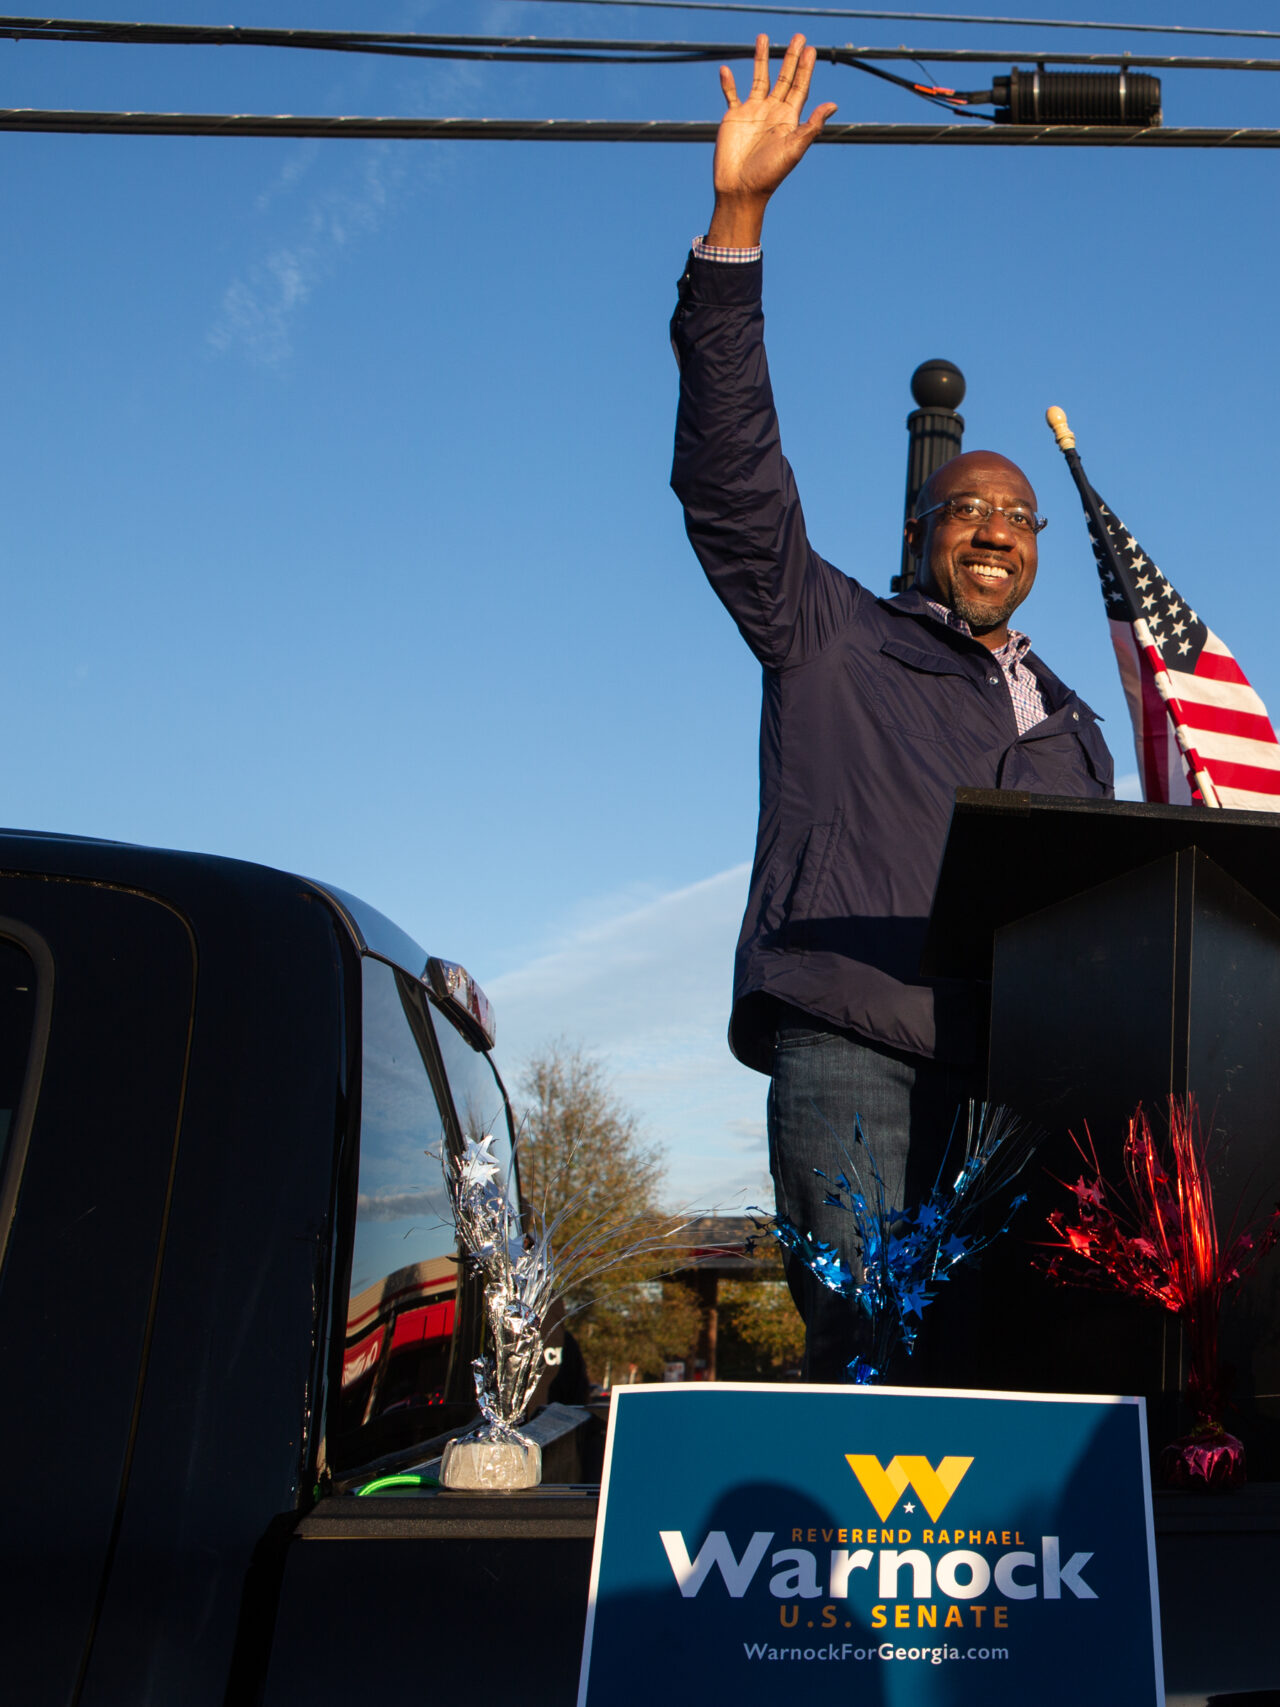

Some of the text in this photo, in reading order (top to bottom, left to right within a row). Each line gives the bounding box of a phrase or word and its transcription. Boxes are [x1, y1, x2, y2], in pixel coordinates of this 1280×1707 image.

[791, 1528, 1026, 1546] REVEREND RAPHAEL
[659, 1530, 1099, 1600] Warnock
[780, 1605, 1010, 1629] U.S. SENATE
[743, 1642, 1010, 1665] WarnockForGeorgia.com
